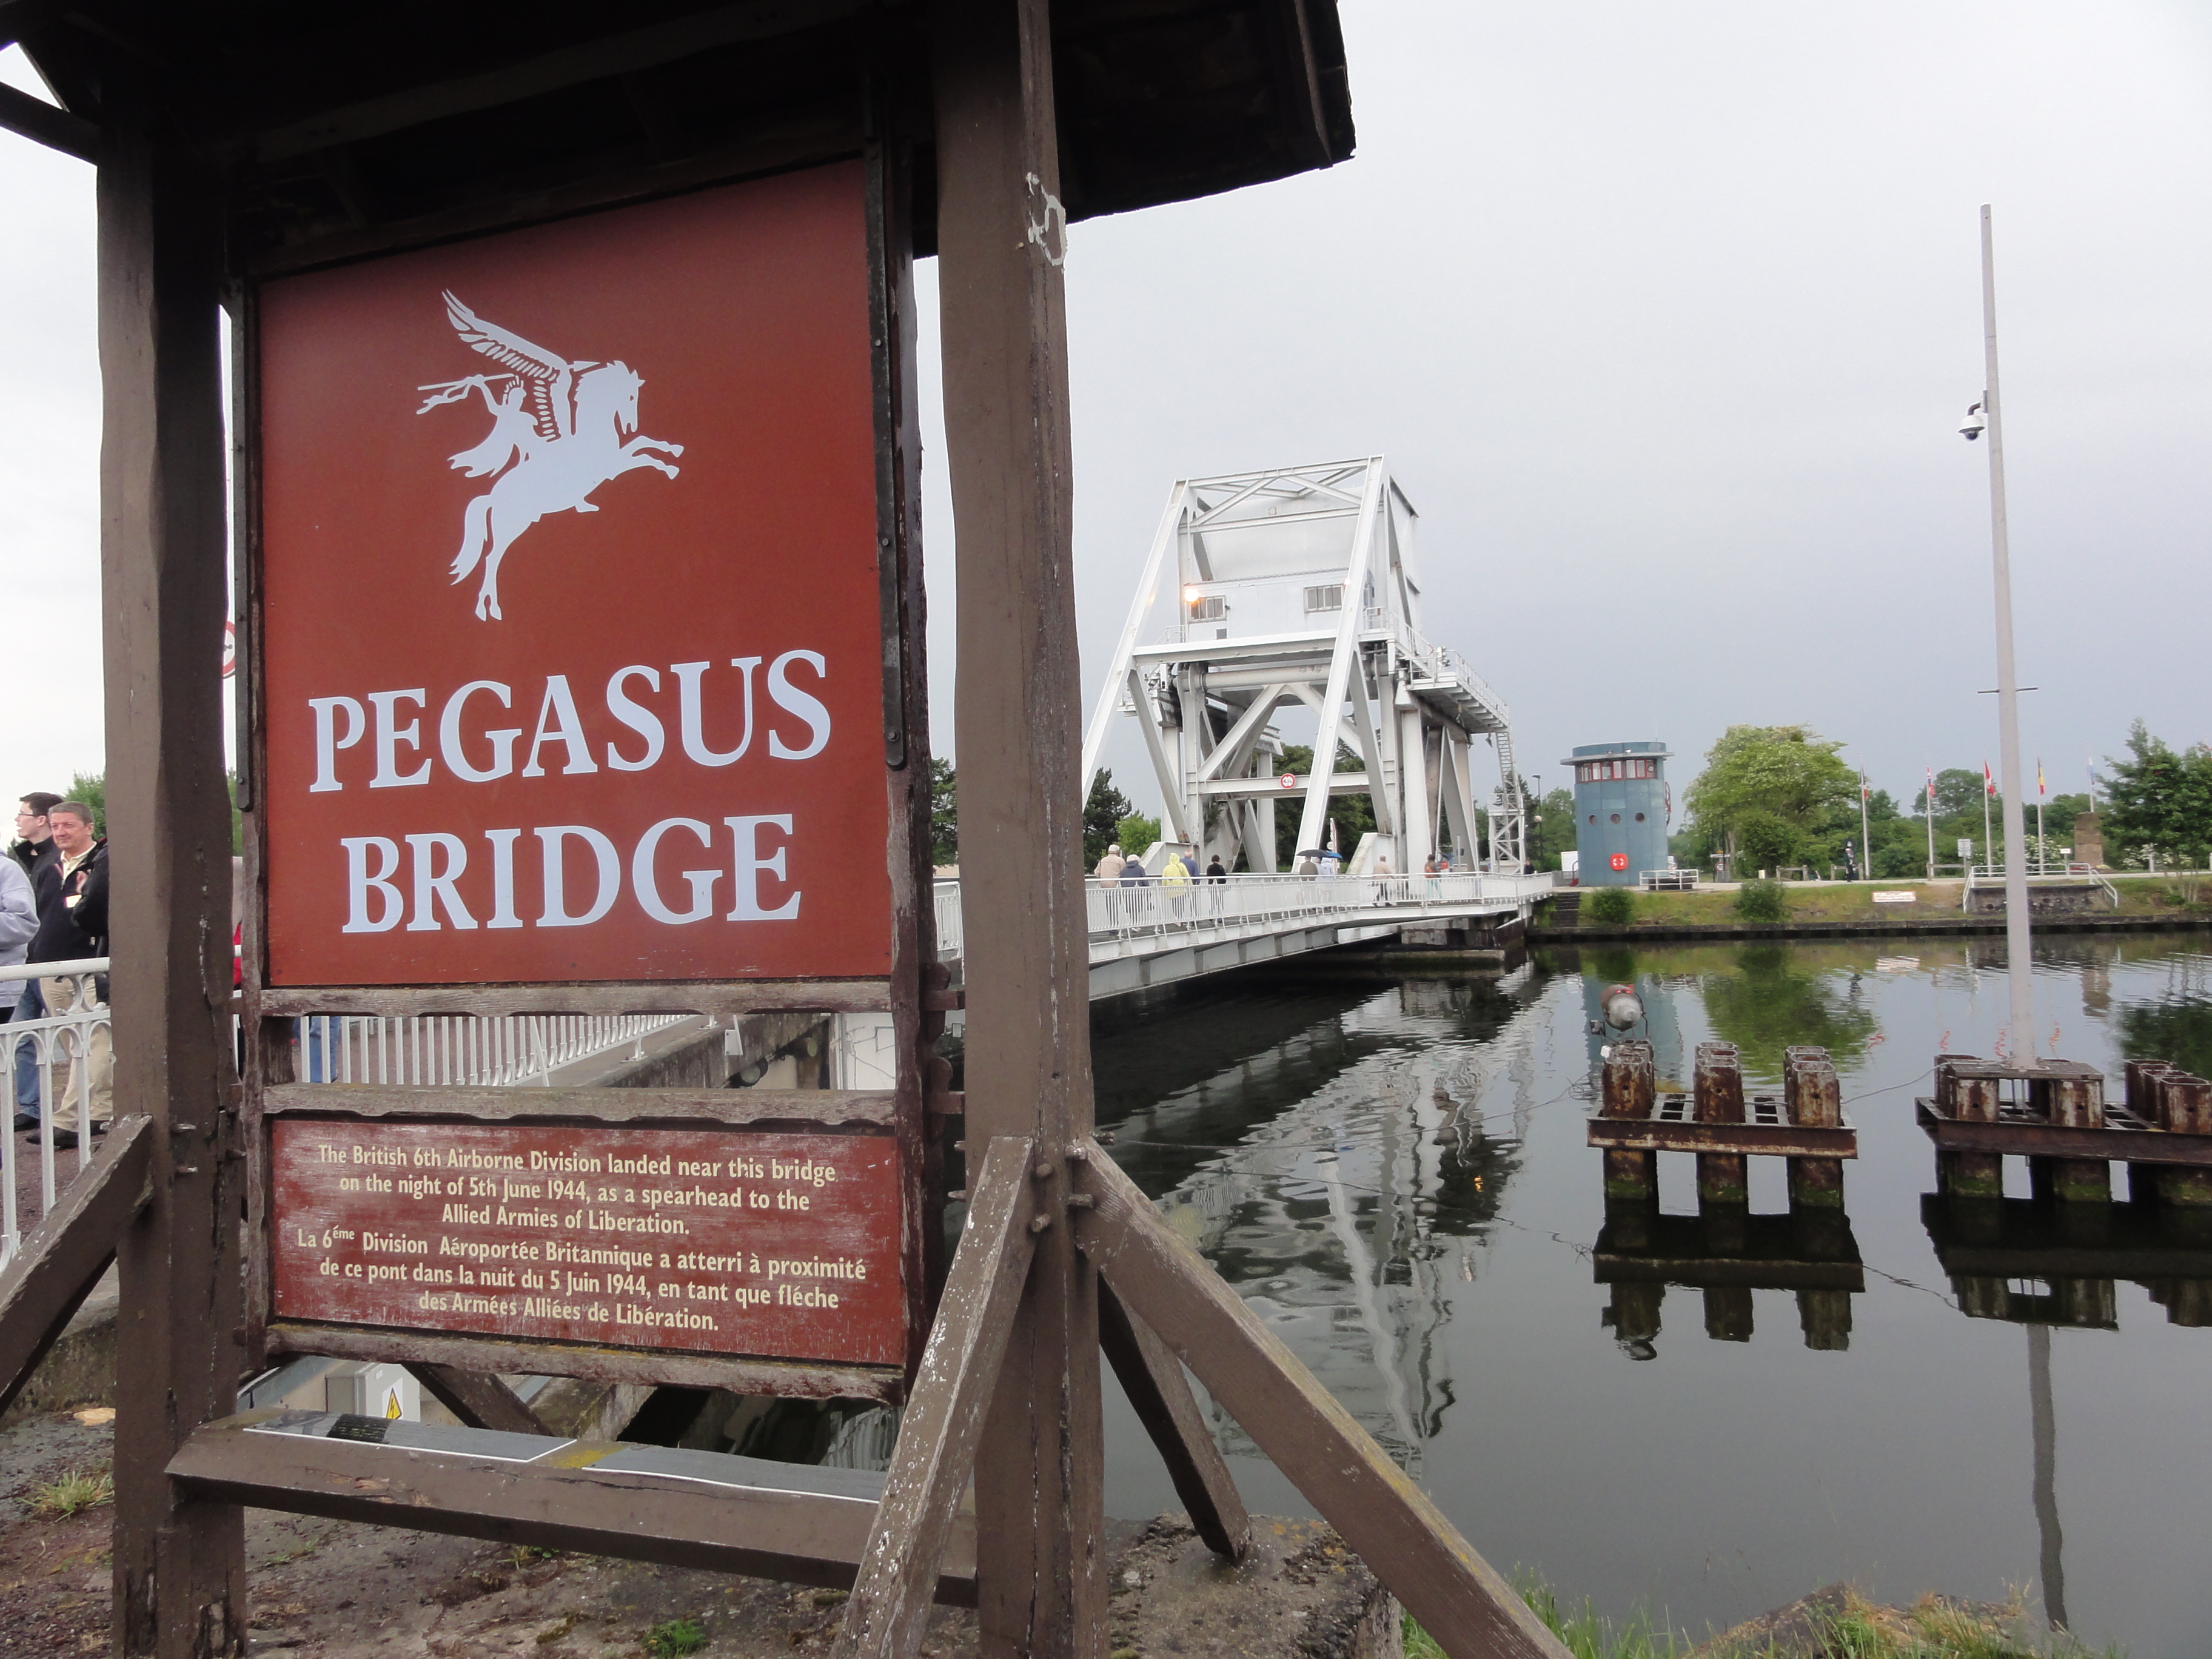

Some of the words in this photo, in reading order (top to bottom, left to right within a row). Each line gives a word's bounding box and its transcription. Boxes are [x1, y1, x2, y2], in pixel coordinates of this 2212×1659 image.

[309, 649, 831, 792] PEGASUS
[341, 814, 802, 933] BRIDGE
[318, 1144, 347, 1164] The
[354, 1145, 407, 1165] British
[414, 1146, 441, 1168] 6th
[447, 1148, 523, 1170] Airborne
[531, 1151, 600, 1172] Division
[608, 1153, 670, 1175] landed
[679, 1162, 721, 1176] near
[728, 1158, 763, 1178] this
[340, 1178, 360, 1191] on
[366, 1173, 392, 1192] the
[399, 1175, 441, 1199] night
[447, 1176, 464, 1195] of
[470, 1177, 496, 1196] 5th
[503, 1175, 540, 1202] June
[548, 1180, 591, 1204] 1944,
[598, 1188, 617, 1201] as
[625, 1189, 635, 1202] a
[642, 1185, 741, 1209] spearhead
[749, 1190, 769, 1208] to
[777, 1189, 809, 1210] the
[442, 1204, 489, 1224] Allied
[497, 1206, 557, 1227] Armies
[565, 1210, 582, 1228] of
[589, 1210, 689, 1234] Liberation.
[298, 1230, 317, 1247] La
[364, 1232, 428, 1253] Division
[440, 1236, 538, 1262] Aéroportée
[546, 1241, 652, 1267] Britannique
[660, 1254, 670, 1267] a
[678, 1252, 741, 1272] atterri
[750, 1253, 760, 1273] à
[768, 1256, 865, 1280] proximité
[320, 1257, 338, 1275] de
[346, 1264, 362, 1277] ce
[369, 1264, 407, 1284] pont
[414, 1262, 452, 1283] dans
[460, 1265, 474, 1284] la
[481, 1267, 515, 1287] nuit
[521, 1269, 543, 1289] du
[551, 1270, 560, 1289] 5
[566, 1272, 599, 1296] Juin
[608, 1274, 651, 1299] 1944,
[659, 1283, 680, 1298] en
[688, 1281, 728, 1301] tant
[736, 1289, 770, 1309] que
[779, 1284, 838, 1308] fléche
[419, 1291, 447, 1310] des
[452, 1293, 517, 1315] Armées
[524, 1298, 580, 1319] Alliées
[588, 1302, 609, 1322] de
[617, 1304, 718, 1330] Libération.
